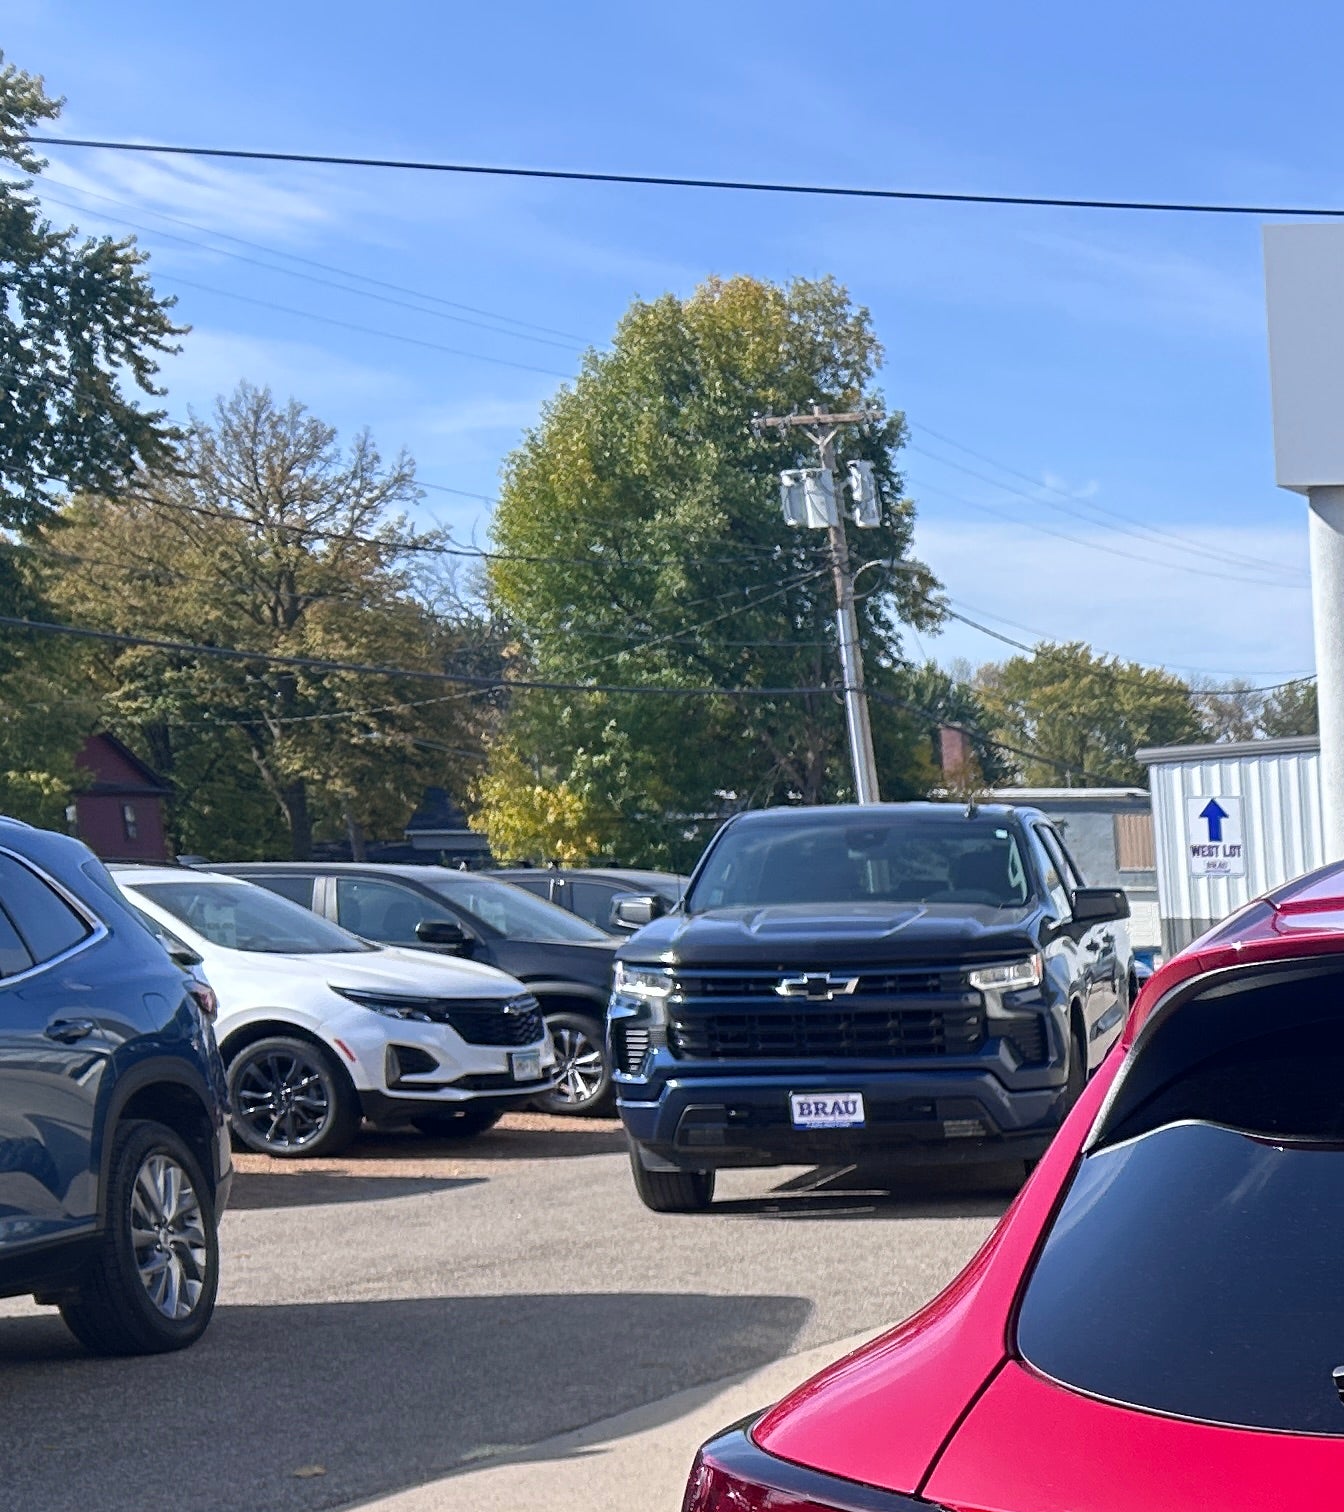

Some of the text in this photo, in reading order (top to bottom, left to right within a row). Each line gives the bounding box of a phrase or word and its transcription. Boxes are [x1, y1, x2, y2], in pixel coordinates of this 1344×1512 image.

[1190, 844, 1242, 858] WEST LOT
[797, 1100, 858, 1117] BRAU
